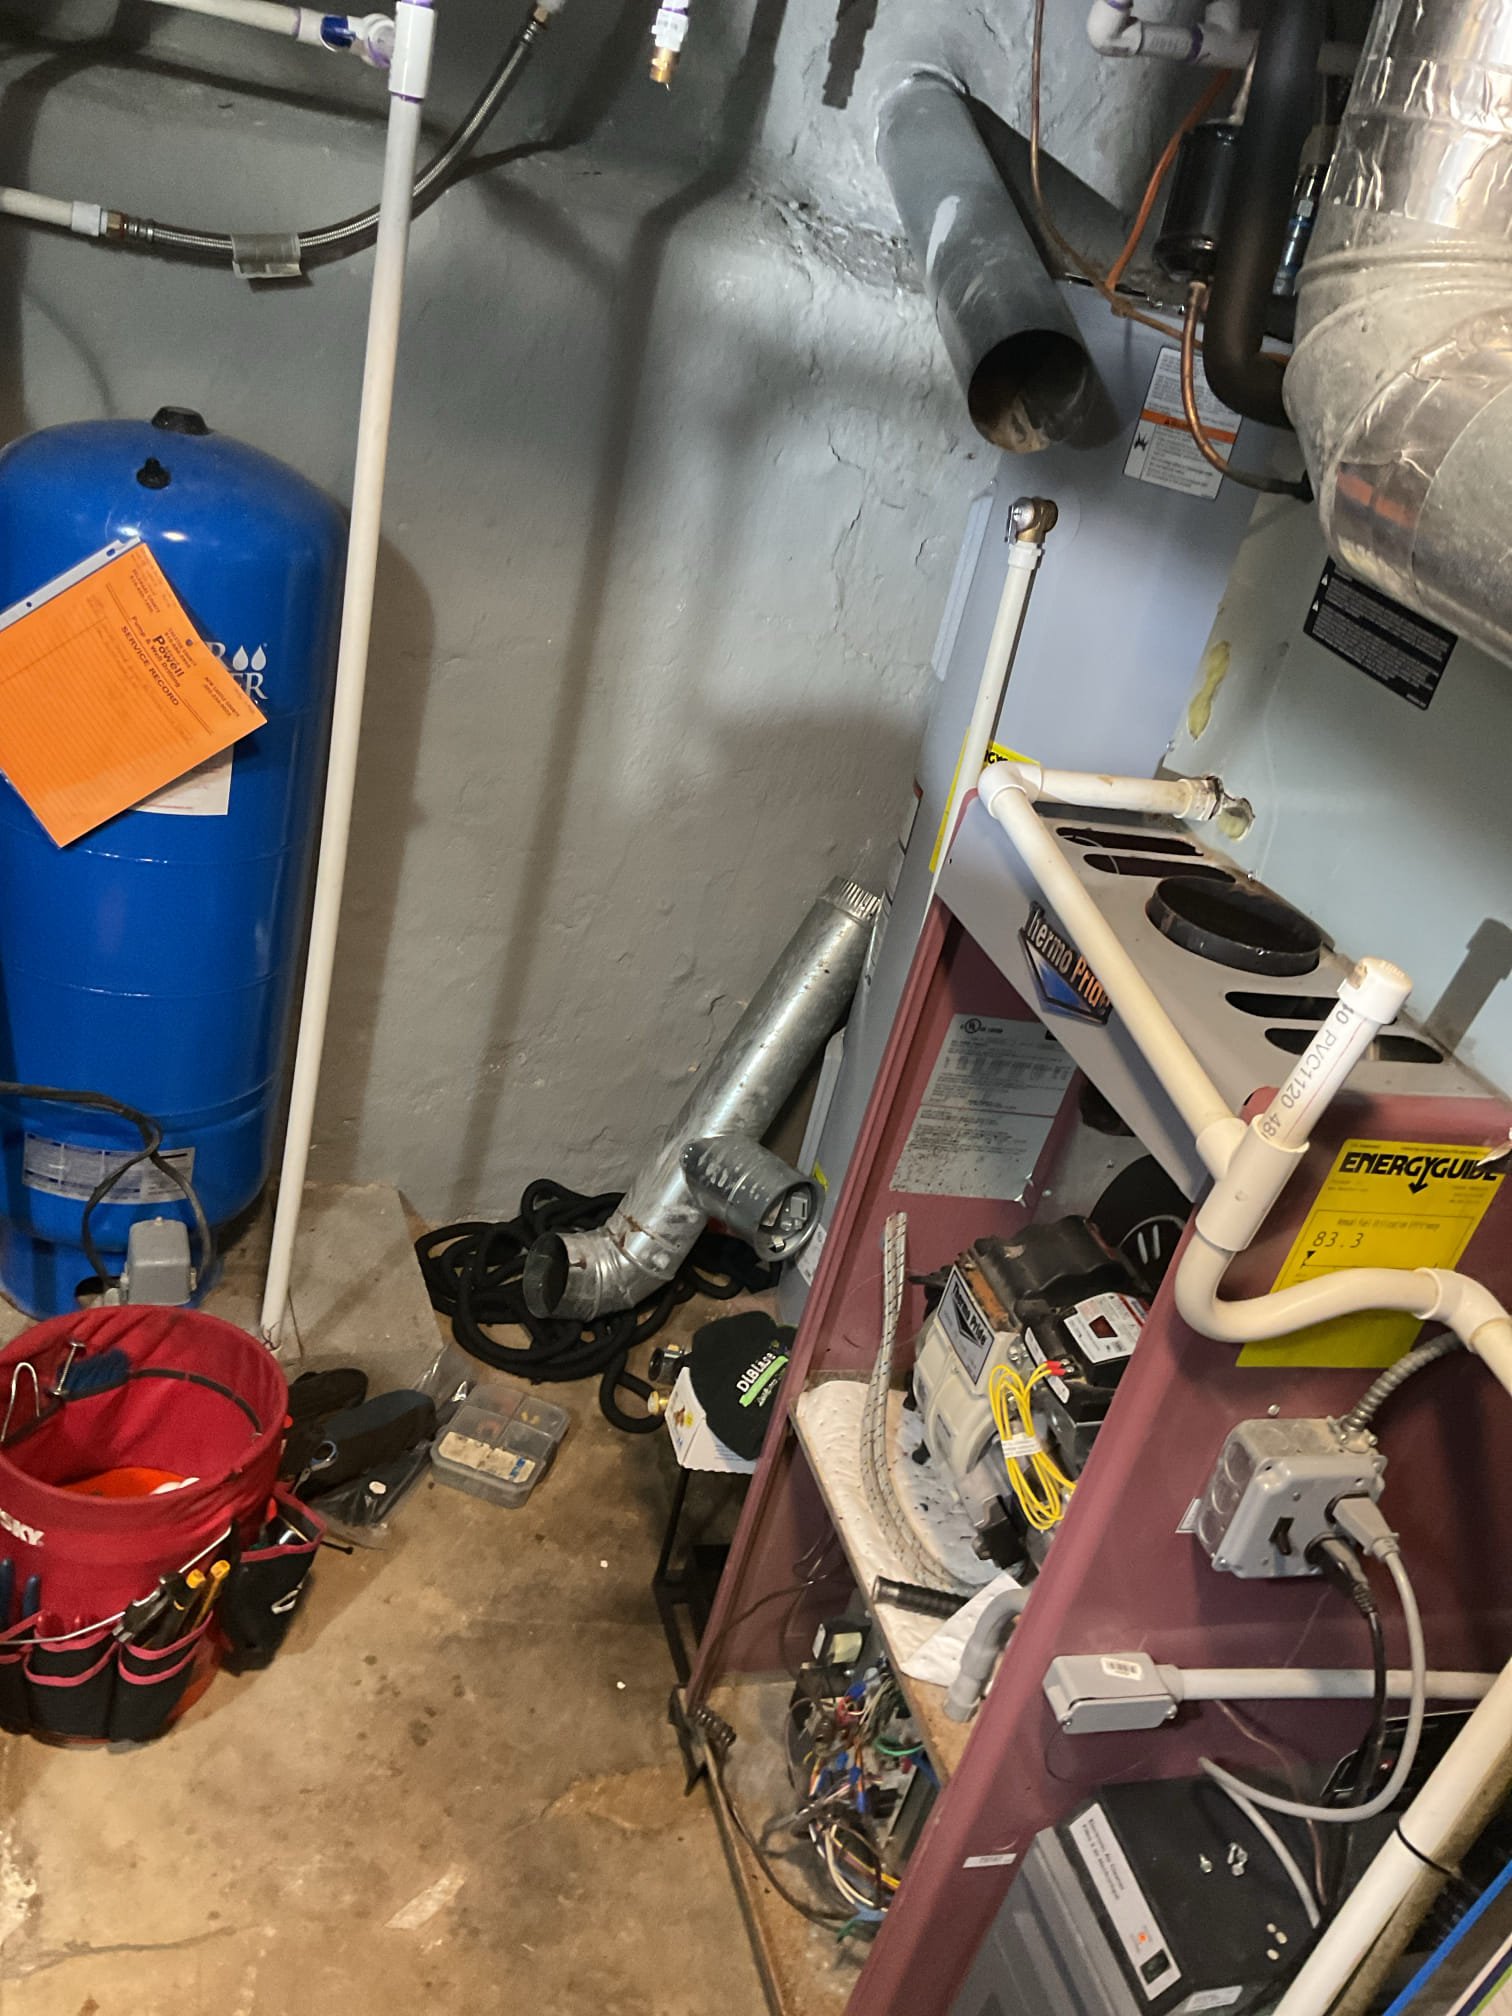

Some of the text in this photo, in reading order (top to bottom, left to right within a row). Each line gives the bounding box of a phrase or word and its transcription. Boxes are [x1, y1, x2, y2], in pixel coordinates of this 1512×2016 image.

[121, 626, 150, 667] SERVICE
[149, 667, 180, 706] RECORD
[150, 645, 163, 661] Well
[152, 635, 185, 678] Powell
[1281, 1029, 1337, 1109] PVC1120
[1262, 1113, 1282, 1140] 48
[1312, 1231, 1365, 1249] 83.3
[0, 1507, 45, 1547] SKY
